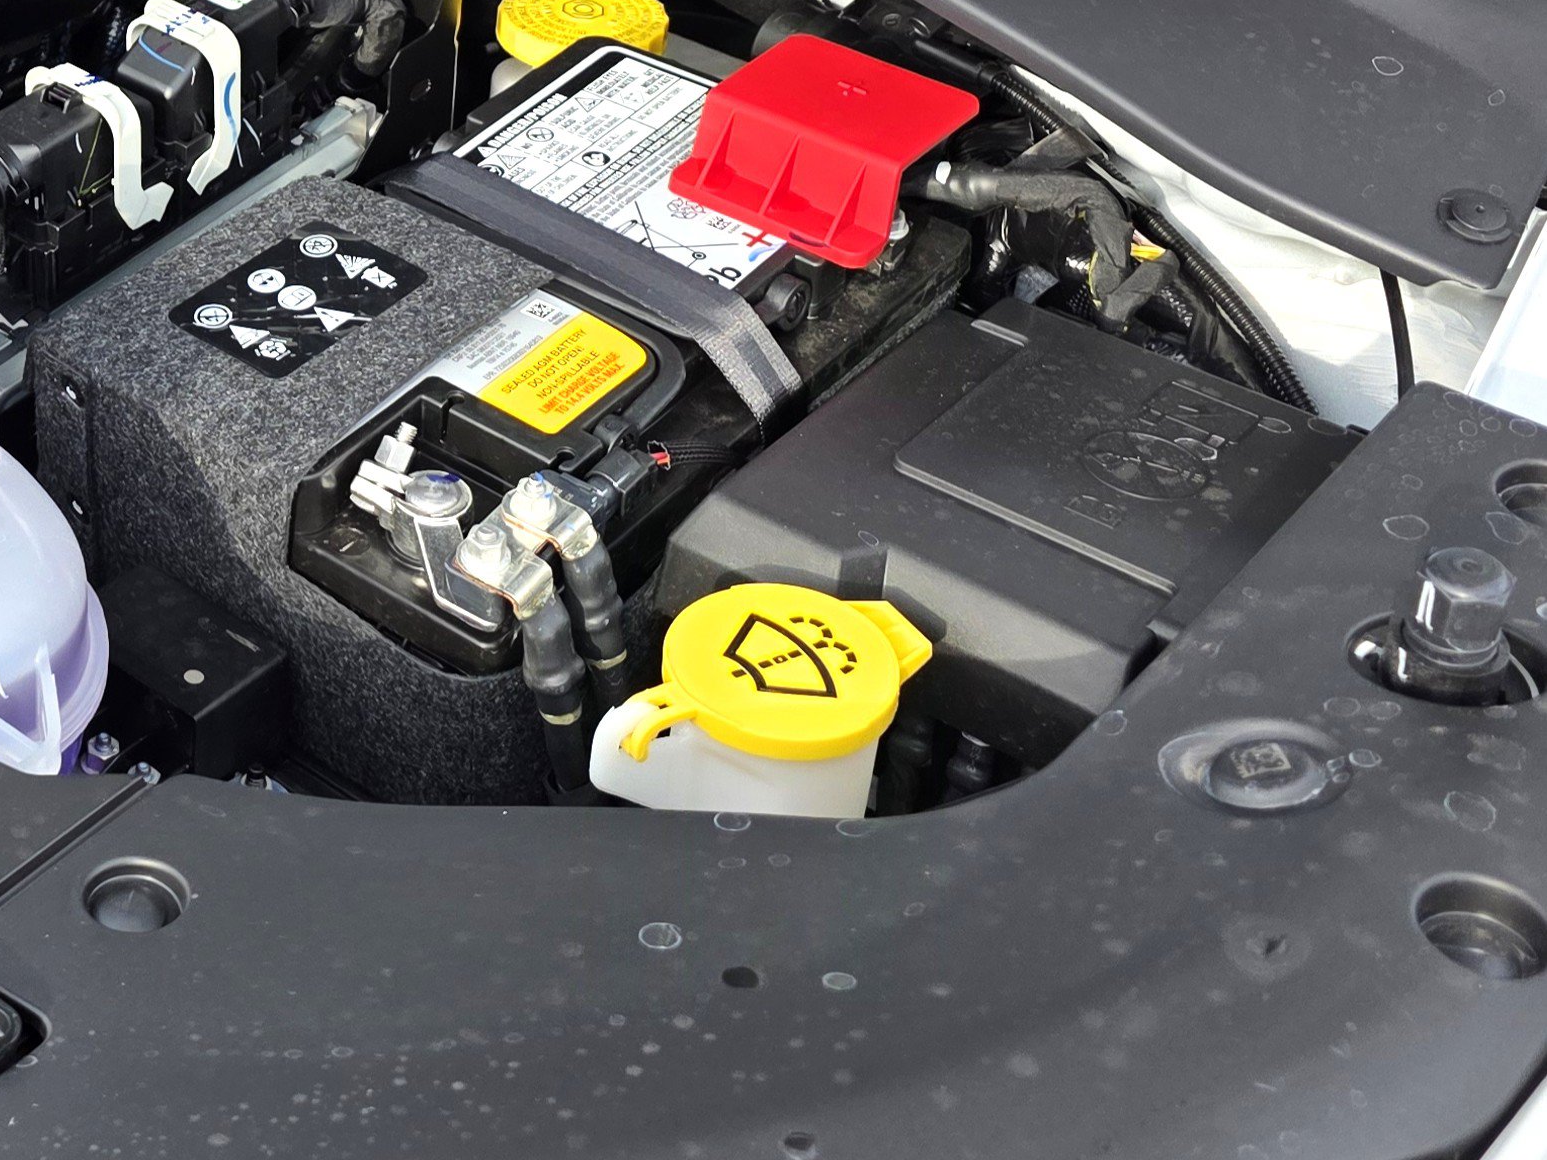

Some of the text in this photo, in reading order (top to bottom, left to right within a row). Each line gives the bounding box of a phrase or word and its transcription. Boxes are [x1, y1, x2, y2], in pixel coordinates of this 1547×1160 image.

[499, 367, 536, 395] SEALED
[531, 354, 554, 371] AGM
[548, 327, 588, 357] BATTERY
[526, 376, 544, 389] DO
[538, 363, 560, 379] NOT
[535, 349, 601, 400] NON-SPILLABLE
[537, 350, 621, 414] LIMIT CHARGE VOLTAGE
[553, 403, 570, 415] TO
[579, 374, 608, 395] VOLTS
